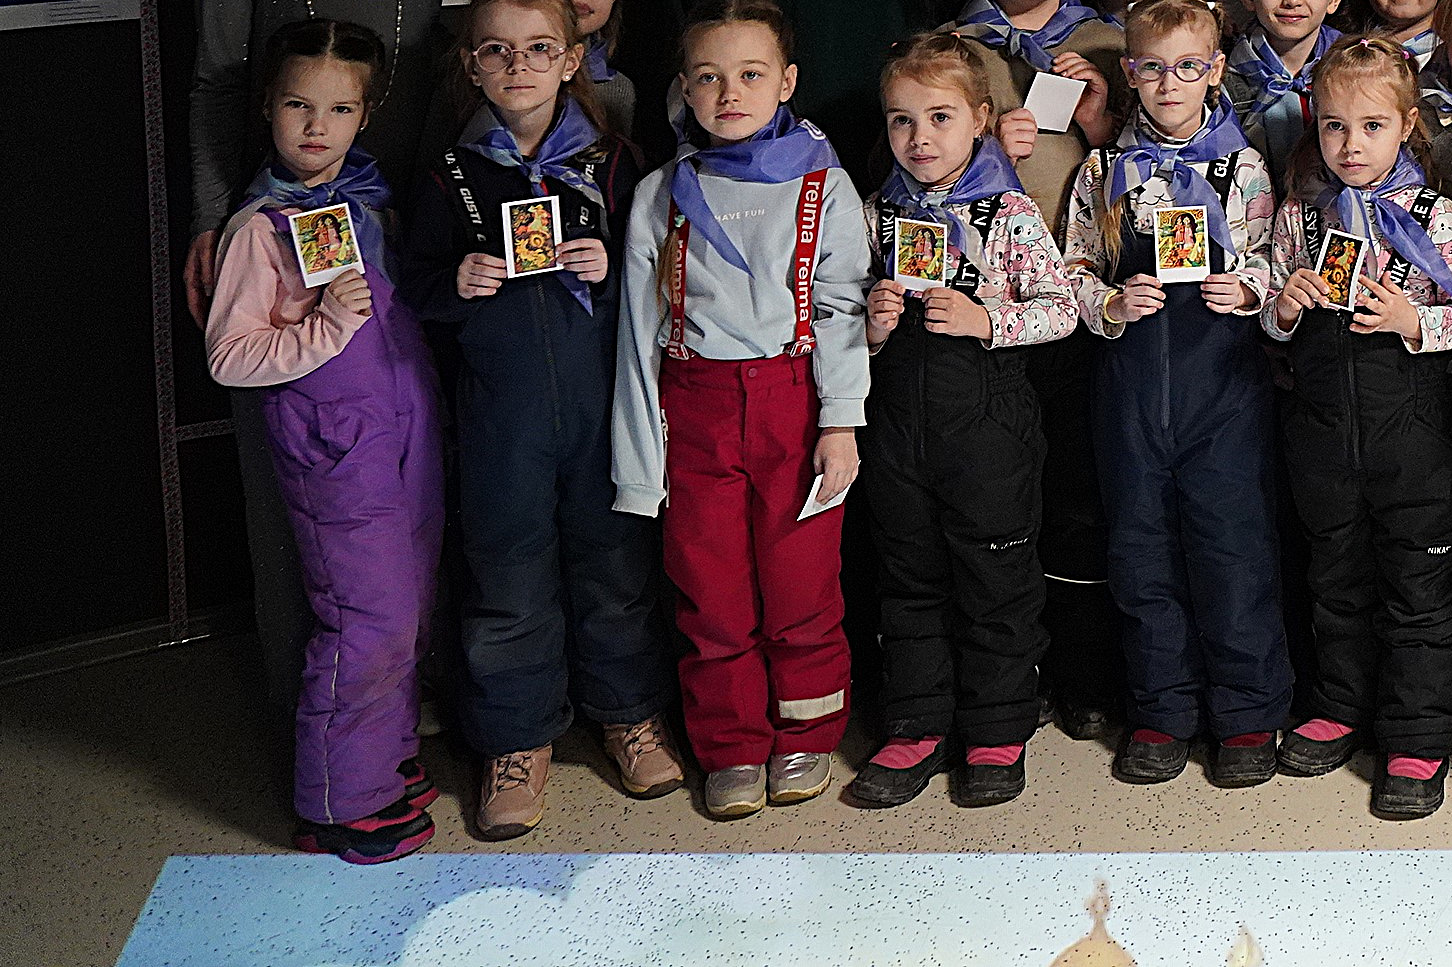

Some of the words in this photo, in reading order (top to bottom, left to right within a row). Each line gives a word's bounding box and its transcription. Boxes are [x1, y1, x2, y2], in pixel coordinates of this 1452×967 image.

[460, 187, 482, 224] GUSTI
[714, 211, 741, 222] HAVE
[744, 208, 766, 218] FUN
[800, 181, 821, 243] reima
[798, 257, 811, 322] reima
